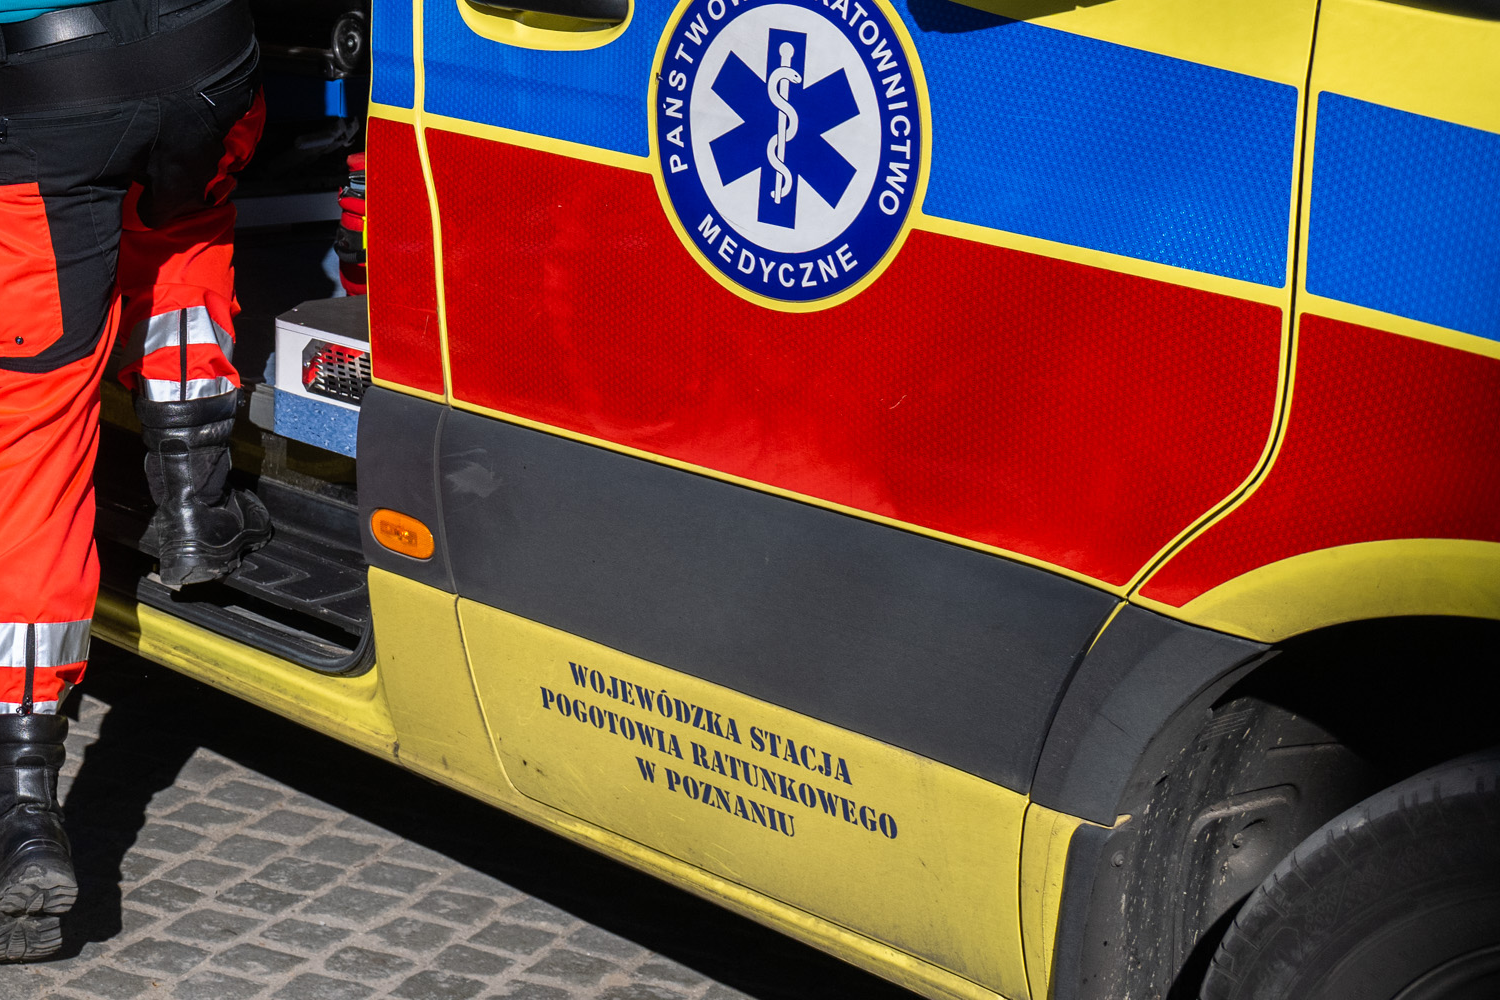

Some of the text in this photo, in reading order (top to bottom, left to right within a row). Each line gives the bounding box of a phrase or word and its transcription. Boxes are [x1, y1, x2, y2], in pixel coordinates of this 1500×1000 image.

[697, 213, 859, 288] MEDYCZNE
[539, 685, 899, 840] POGOTOWIA RATUNKOWEGO
[568, 660, 853, 786] WOJEWÓDZKA STACJA
[635, 755, 796, 838] W POZNANIU
